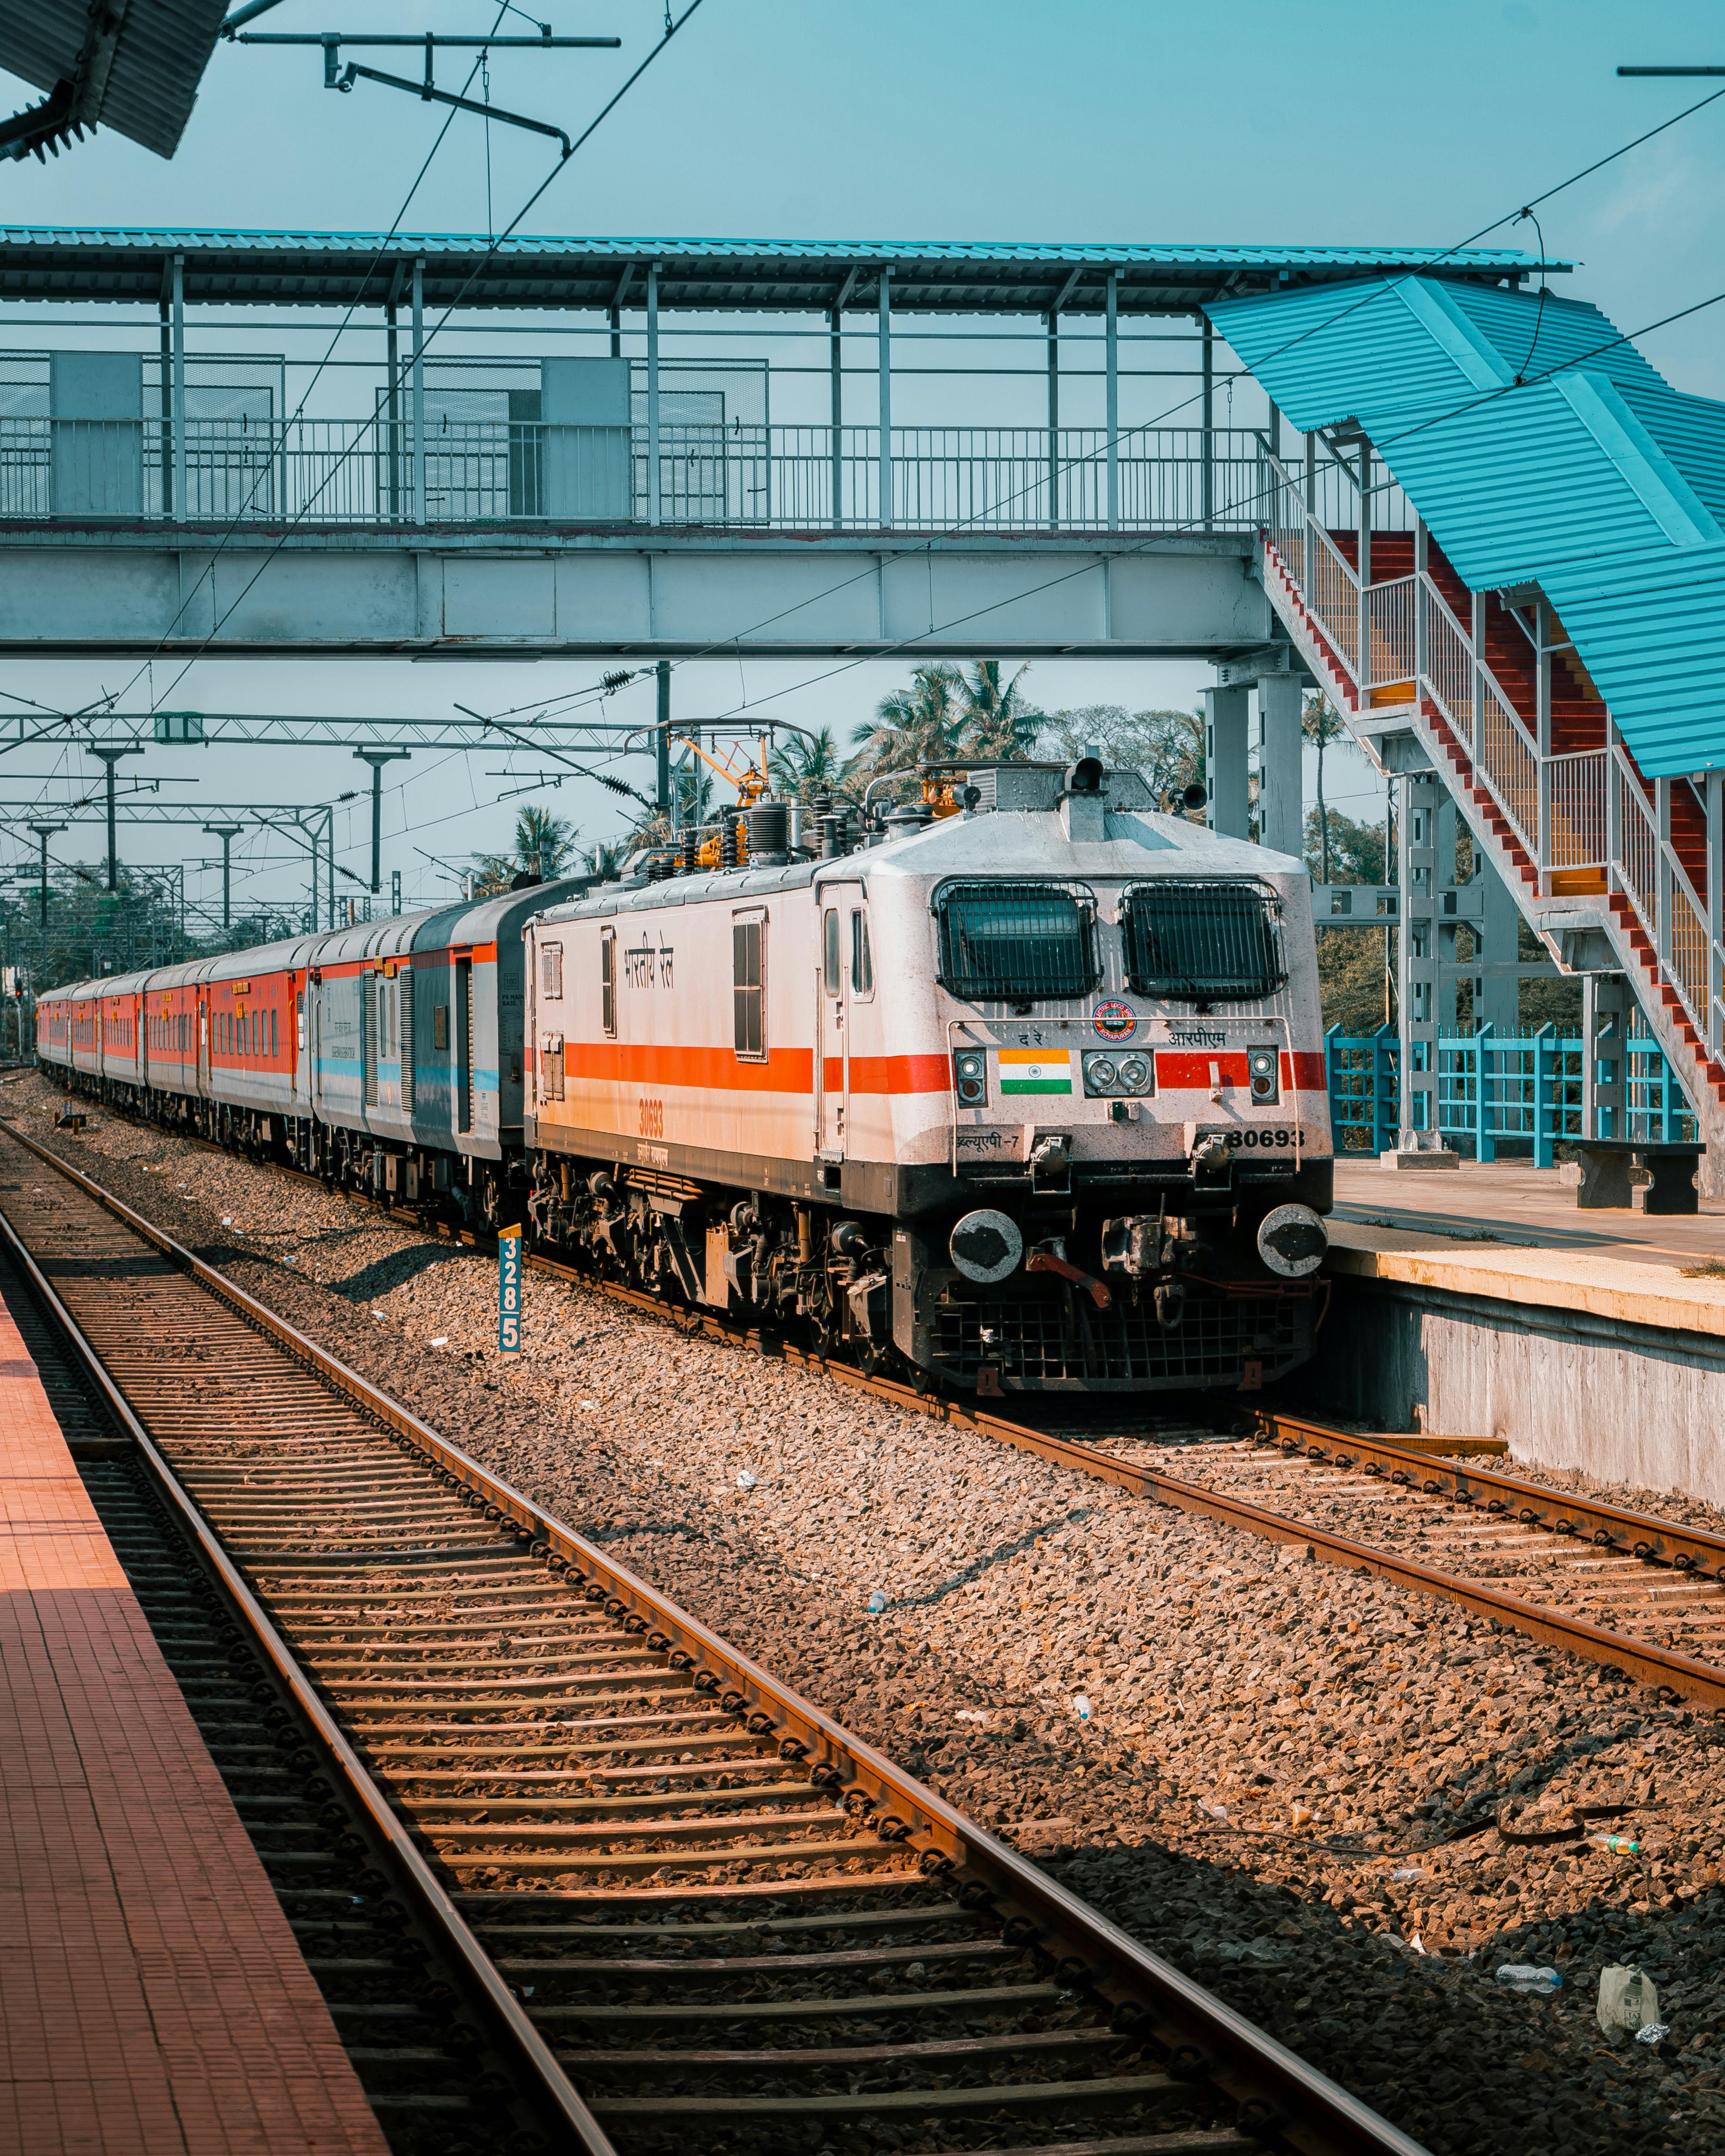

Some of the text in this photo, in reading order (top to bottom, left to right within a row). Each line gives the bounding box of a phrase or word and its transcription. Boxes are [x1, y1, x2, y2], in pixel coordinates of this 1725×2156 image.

[625, 928, 673, 989] भारतीय रेल
[1096, 1003, 1109, 1018] LECTRIC
[1124, 1008, 1132, 1018] SHE
[1100, 1028, 1131, 1039] ROYAPURAM
[1169, 1026, 1226, 1049] आरपीएम
[639, 1098, 663, 1138] 30693
